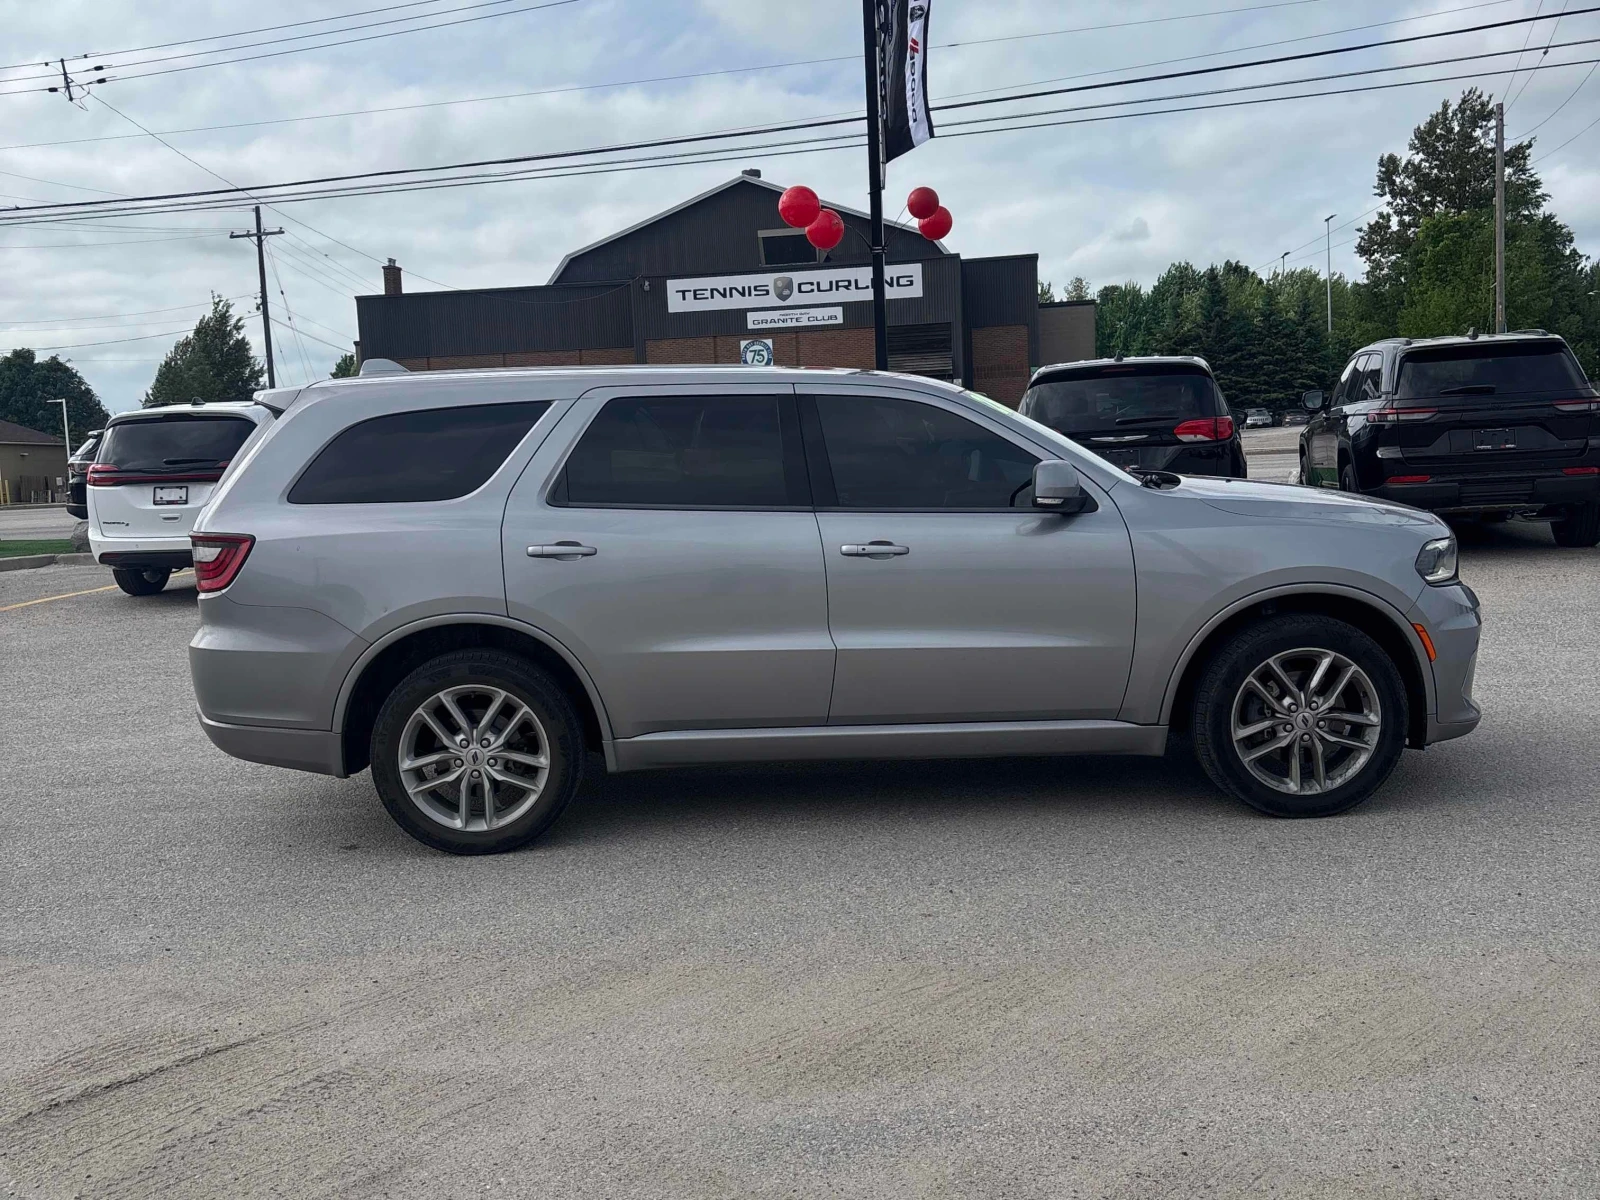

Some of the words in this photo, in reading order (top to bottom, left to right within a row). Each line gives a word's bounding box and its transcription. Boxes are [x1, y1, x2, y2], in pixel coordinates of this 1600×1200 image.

[675, 284, 770, 301] TENNIS
[752, 316, 803, 326] GRANITE
[807, 314, 838, 322] CLUB
[749, 349, 765, 364] 75
